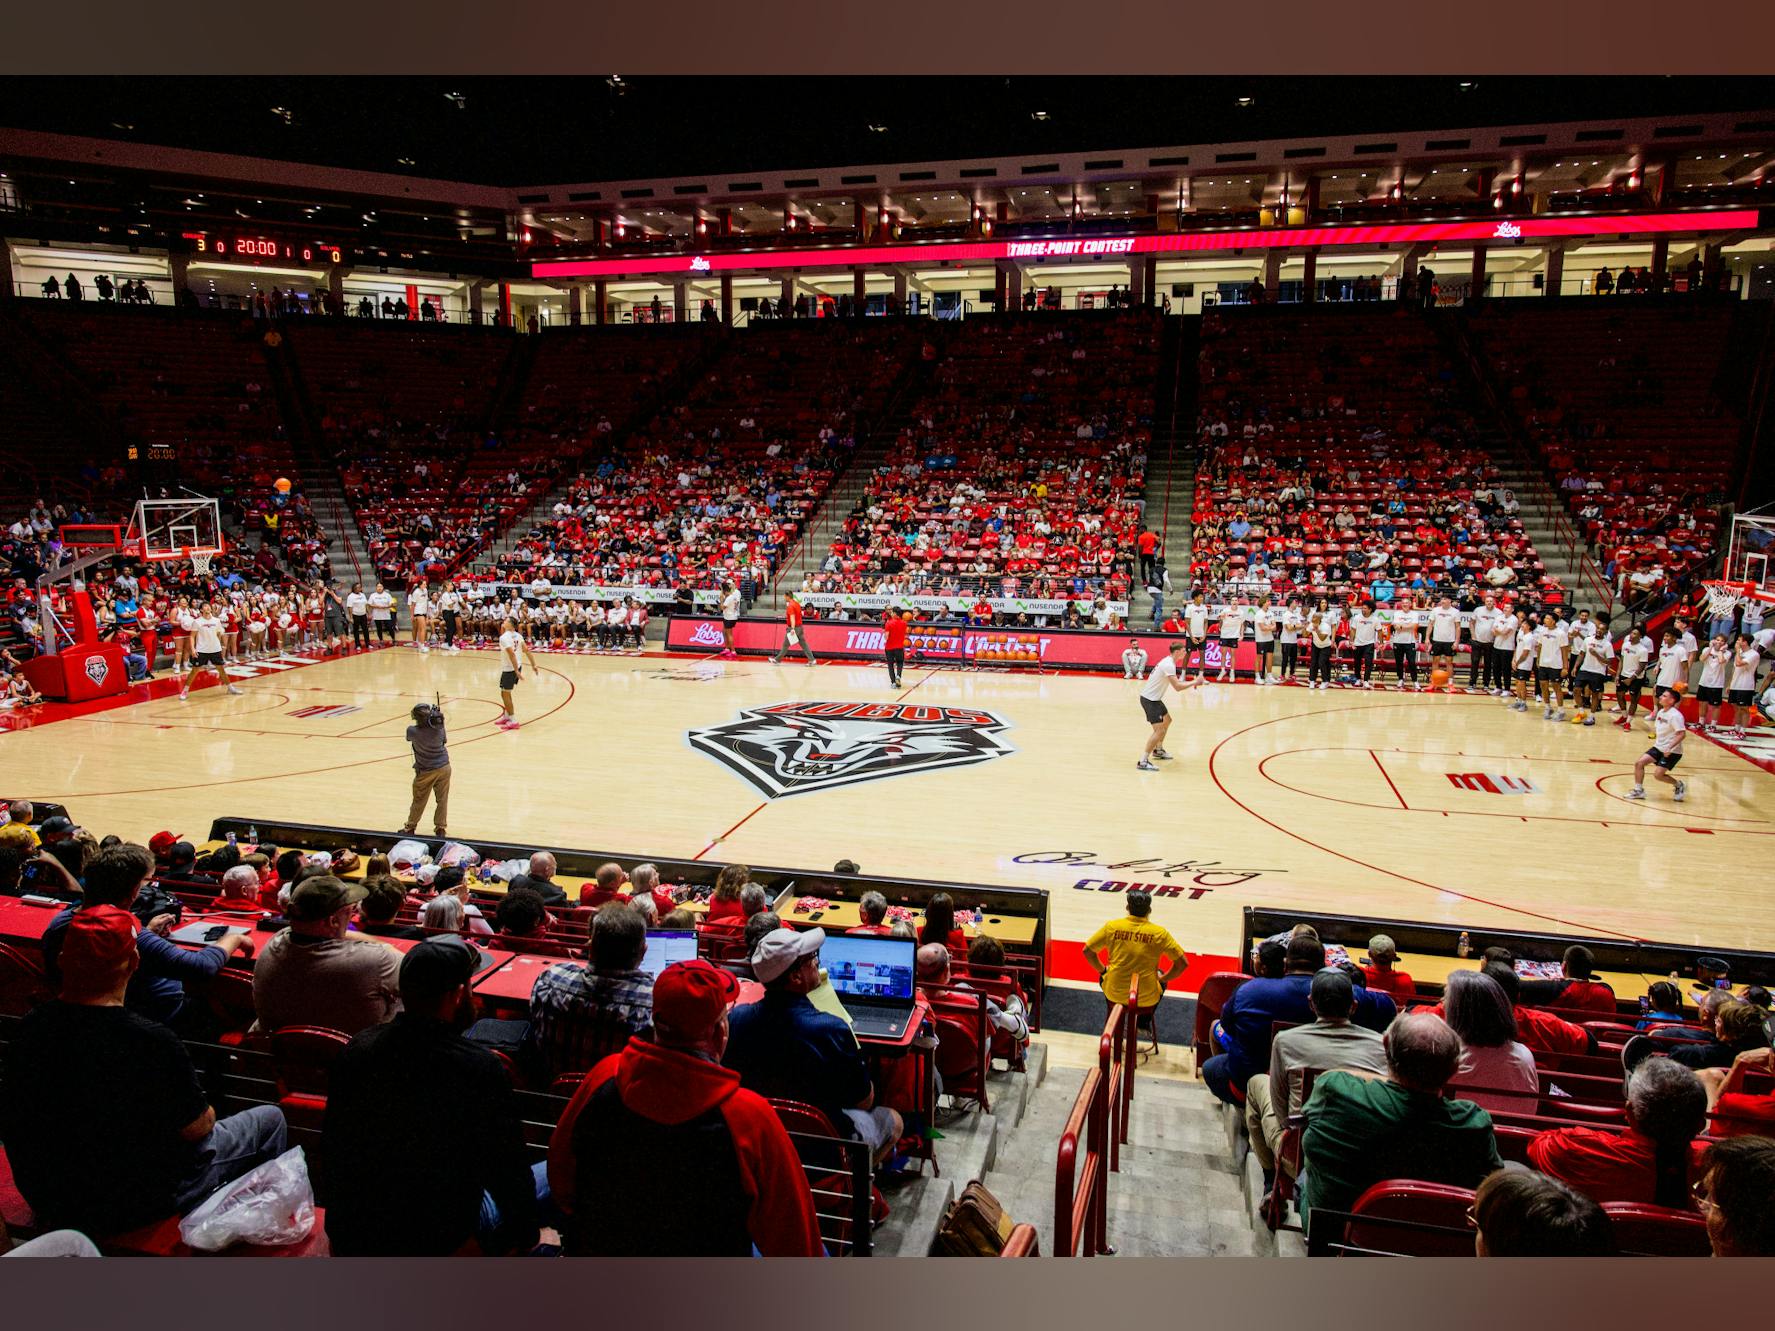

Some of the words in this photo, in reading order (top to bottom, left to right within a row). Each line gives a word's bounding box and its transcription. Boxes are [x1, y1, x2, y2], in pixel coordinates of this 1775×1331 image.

[198, 239, 205, 251] 3
[217, 242, 224, 252] 0
[237, 239, 276, 256] 20:00
[1010, 242, 1081, 256] THREE-POINT
[1083, 239, 1134, 252] CONTEST
[304, 249, 311, 260] 0
[332, 251, 340, 262] 0
[148, 448, 175, 459] 20:00
[689, 622, 725, 645] Lobos
[761, 702, 993, 725] LOBOS
[1073, 879, 1213, 900] COURT
[1114, 930, 1132, 941] EVENT
[1134, 931, 1154, 944] STAFF
